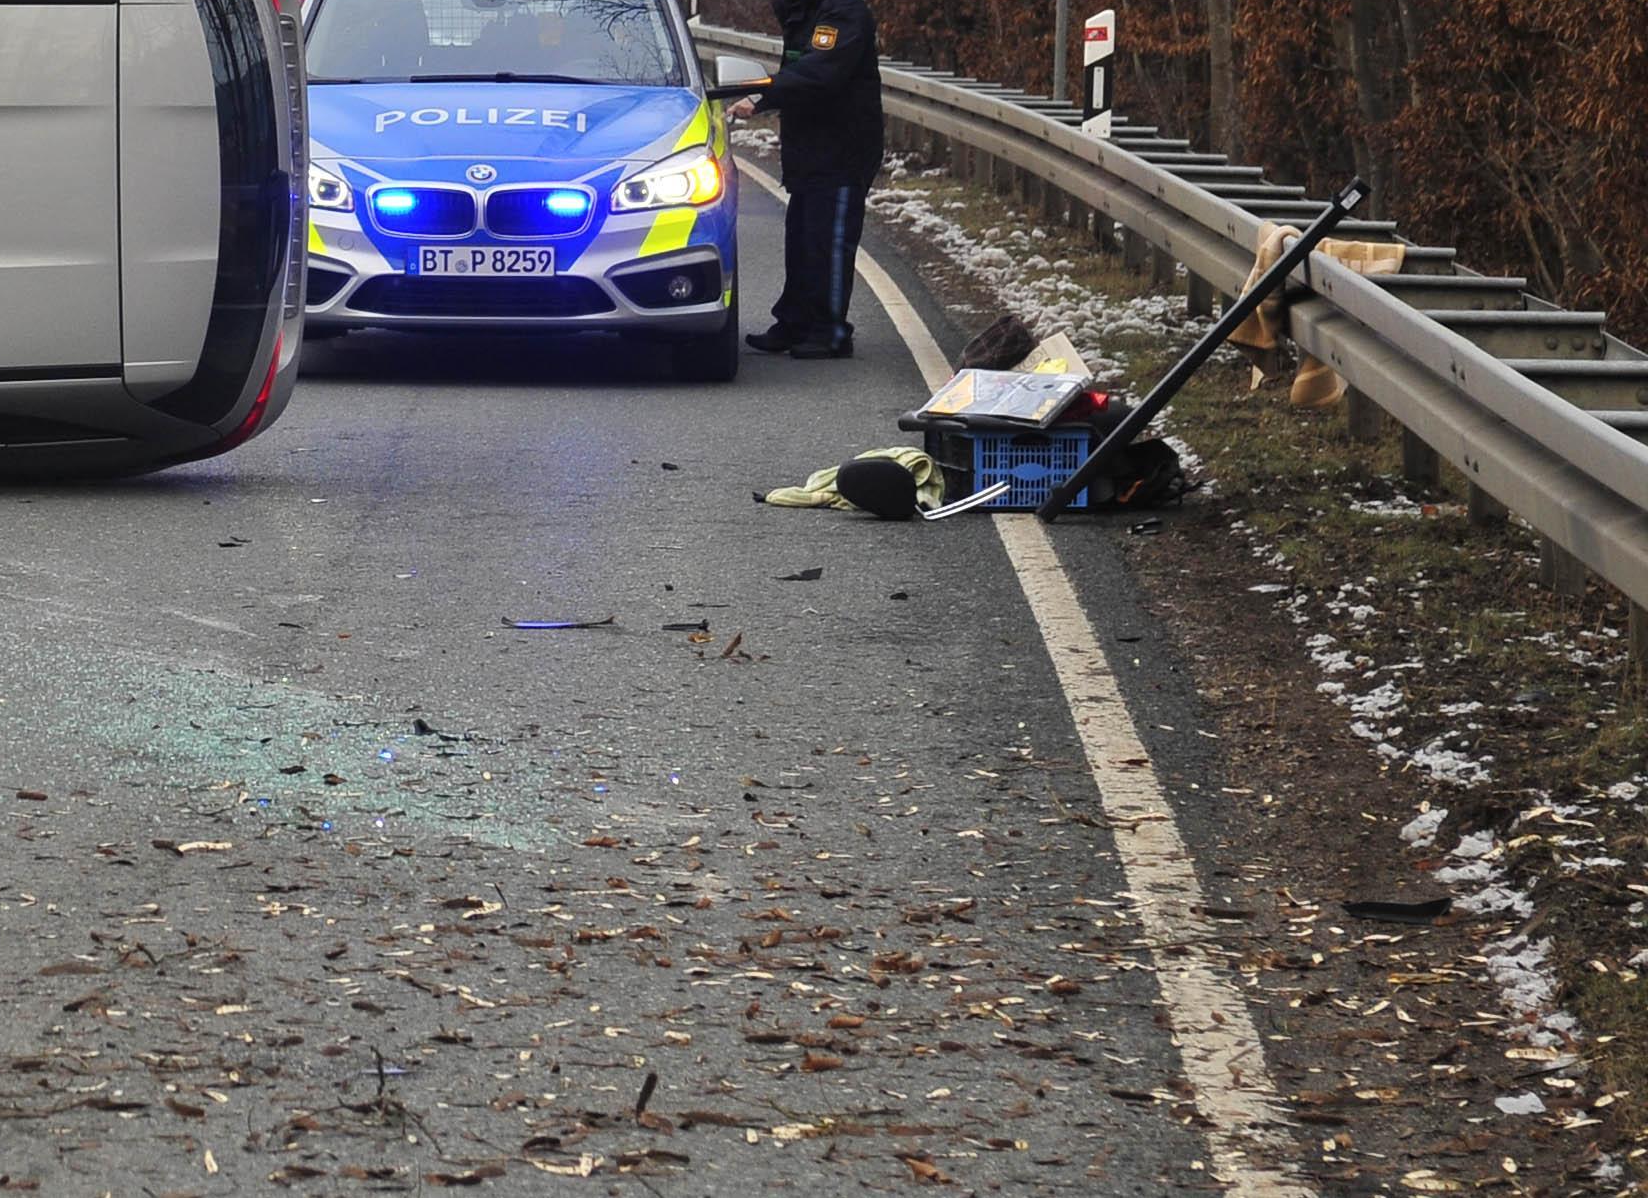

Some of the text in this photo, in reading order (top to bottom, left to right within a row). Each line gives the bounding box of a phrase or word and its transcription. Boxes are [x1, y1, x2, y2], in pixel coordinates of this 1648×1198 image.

[375, 108, 587, 133] POLIZEI
[422, 249, 552, 273] BT P 8259
